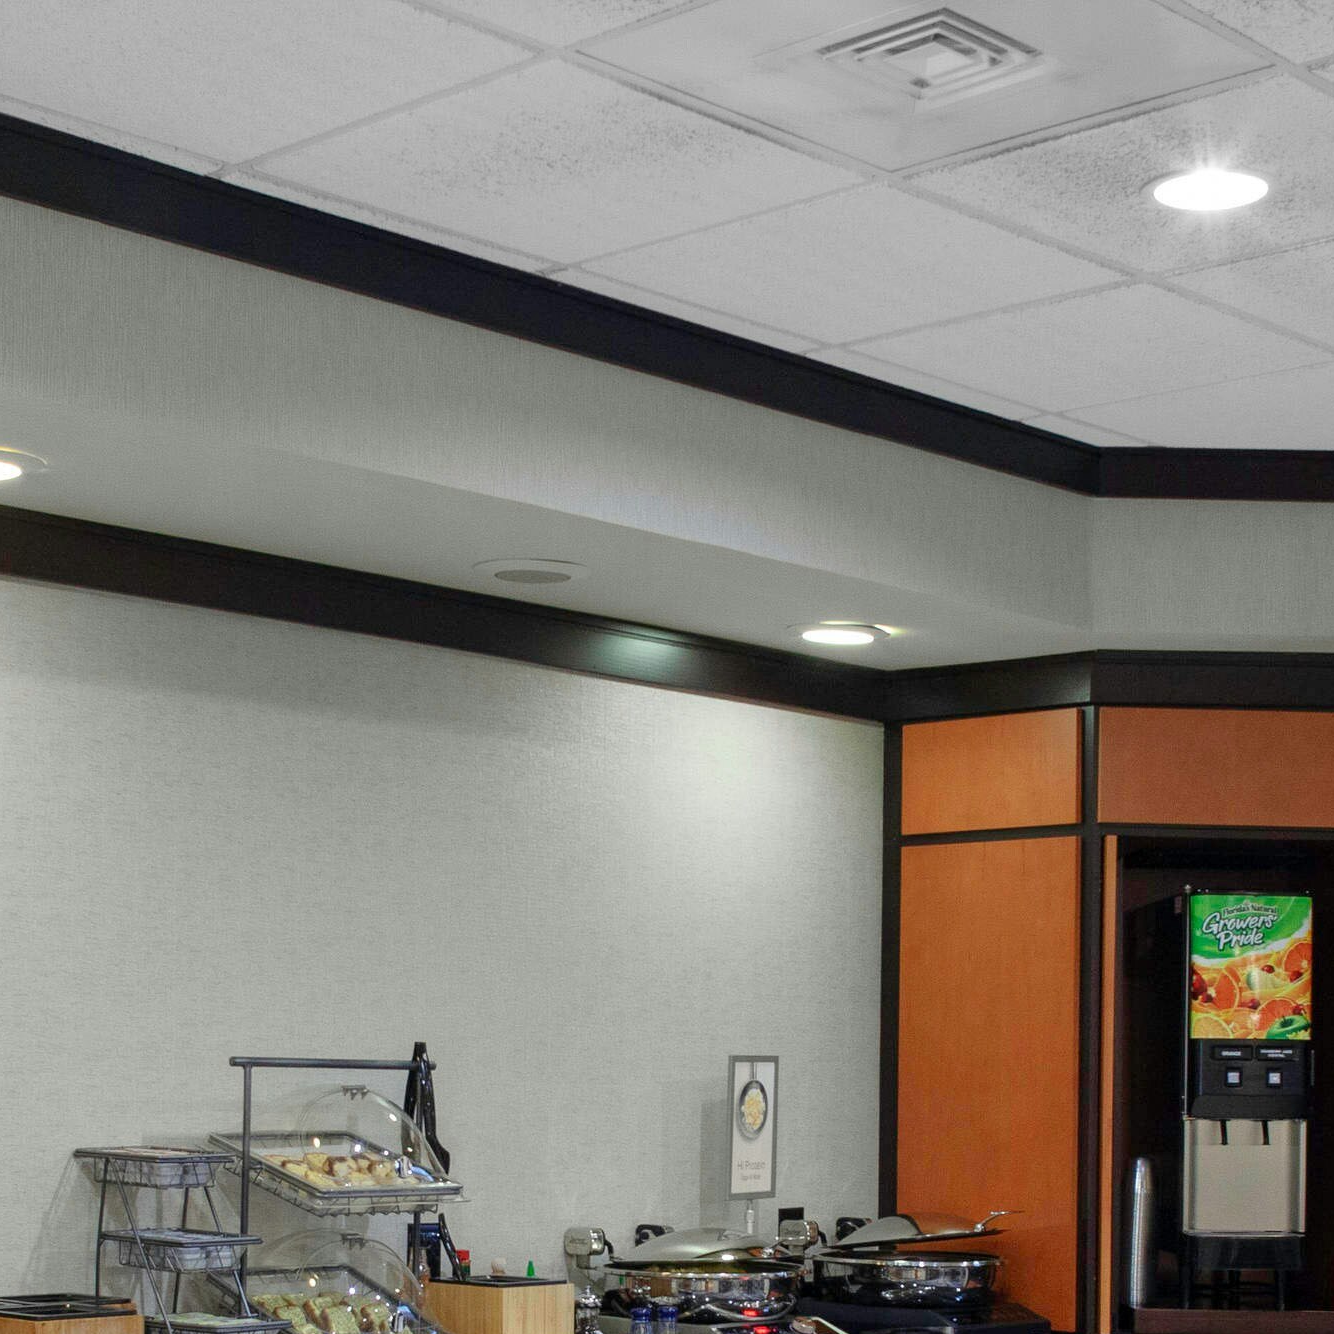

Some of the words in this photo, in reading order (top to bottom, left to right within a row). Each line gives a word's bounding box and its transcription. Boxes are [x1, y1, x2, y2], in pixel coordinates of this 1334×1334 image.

[1251, 902, 1277, 914] Natural
[1202, 912, 1278, 934] Growers'
[1216, 928, 1264, 951] Pride
